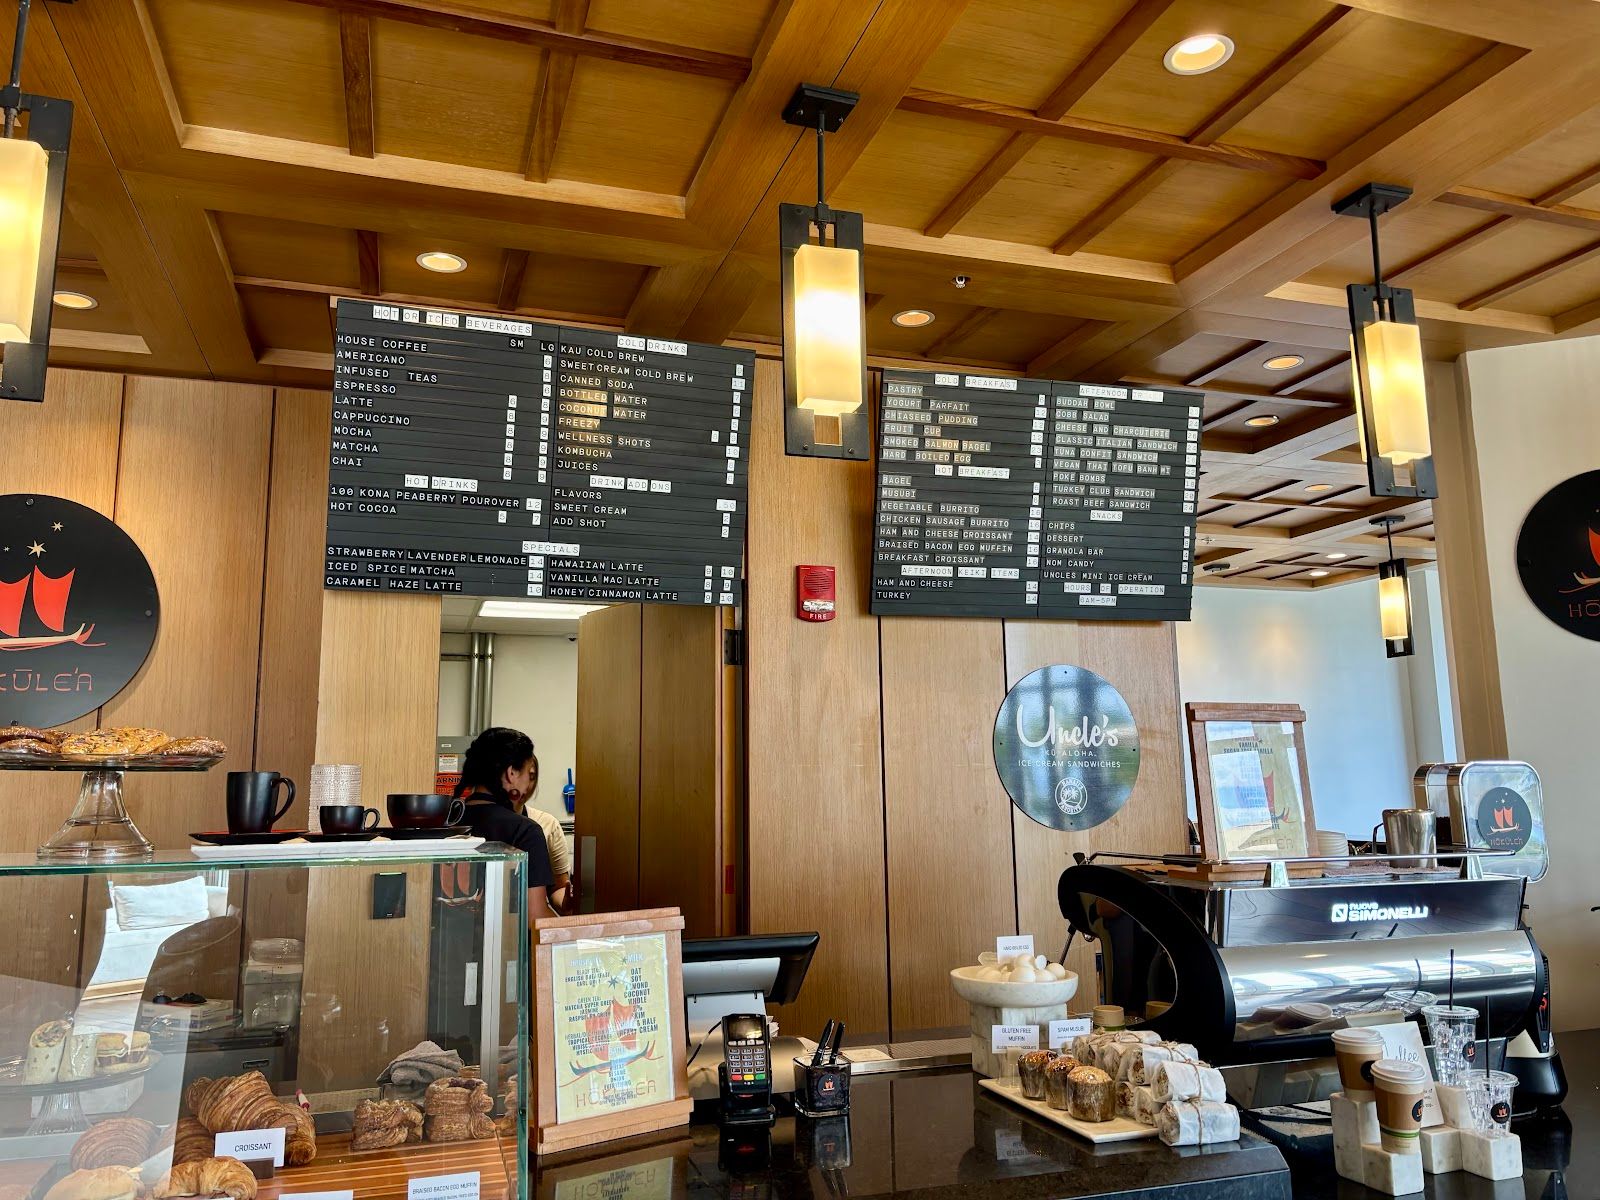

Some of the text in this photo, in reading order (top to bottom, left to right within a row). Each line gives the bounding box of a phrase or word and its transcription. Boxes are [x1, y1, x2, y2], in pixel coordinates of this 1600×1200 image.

[374, 309, 532, 334] HOT OR ICED BEVERAGES
[337, 335, 428, 352] HOUSE COFFEE
[510, 339, 555, 352] SM LG
[618, 338, 687, 354] COLD DRINKS
[336, 351, 406, 365] AMERICANO
[560, 345, 645, 362] KAU COLD BREW
[336, 365, 438, 383] INFUSED TEAS
[560, 360, 694, 383] SWEET CREAM COLD BREW
[335, 381, 397, 394] ESPRESSO
[560, 374, 634, 390] CANNED SODA
[887, 385, 923, 394] PASTRY
[335, 396, 373, 407] LATTE
[560, 388, 648, 405] BOTTLED WATER
[886, 397, 969, 411] YOGURT PARFAIT
[1094, 401, 1115, 410] BOWL
[559, 403, 647, 419] COCONUT WATER
[1055, 410, 1109, 421] COBB SALAD
[334, 410, 410, 426] CAPPUCCINO
[558, 418, 601, 428] FREEZY
[938, 415, 978, 425] PUDDING
[334, 426, 372, 437] MOCHA
[924, 427, 941, 435] CUP
[1055, 423, 1088, 432] CHEESE
[558, 431, 651, 448] WELLNESS SHOTS
[883, 437, 990, 451] SMOKED SALMON BAGEL
[1055, 435, 1178, 450] CLASSIC ITALIAN SANDWICH
[333, 442, 379, 453] MATCHA
[558, 446, 613, 458] KOMBUCHA
[332, 457, 362, 466] CHAI
[915, 452, 971, 463] BOILED EGG
[1080, 450, 1158, 462] CONFIT SANDWICH
[557, 460, 598, 471] JUICES
[1137, 466, 1158, 474] BANH
[406, 477, 476, 490] HOT DRINKS
[591, 477, 670, 491] DRINK ADD ONS
[882, 476, 911, 485] BAGEL
[1079, 475, 1106, 483] BOMBS
[554, 489, 602, 500] FLAVORS
[1052, 485, 1155, 497] TURKEY CLUB SANDWICH
[331, 487, 520, 508] 100 KONA PEABERRY POUROVER
[330, 502, 397, 514] HOT COCOA
[554, 503, 627, 515] SWEET CREAM
[880, 502, 980, 514] VEGETABLE BURRITO
[1053, 498, 1080, 506] ROAST
[1109, 501, 1150, 510] SANDWICH
[553, 517, 607, 528] ADD SHOT
[879, 514, 1009, 528] CHICKEN SAUSAGE BURRITO
[879, 527, 1013, 540] HAM AND CHEESE CROISSANT
[1047, 535, 1084, 543] DESSERT
[523, 543, 579, 553] SPECIALS
[879, 540, 1013, 553] BRAISED BACON EGG MUFFIN
[1046, 547, 1084, 556] GRANOLA
[327, 547, 527, 565] STRAWBERRY LAVENDER LEMONADE
[878, 553, 985, 564] BREAKFAST CROISSANT
[327, 562, 455, 576] ICED SPICE MATCHA
[551, 559, 644, 572] HAWAIIAN LATTE
[1046, 559, 1062, 567] NOM
[326, 576, 462, 591] CARAMEL HAZE LATTE
[550, 573, 660, 586] VANILLA MAC LATTE
[919, 580, 954, 588] CHEESE
[1128, 574, 1153, 582] CREAM
[550, 587, 678, 601] HONEY CINNAMON LATTE
[877, 591, 911, 599] TURKEY
[1017, 704, 1119, 748] Uncle's
[1067, 760, 1121, 768] SANDWICHES
[1348, 906, 1429, 922] SIMONELLI
[630, 967, 642, 975] OAT
[234, 1143, 272, 1153] CROISSANT
